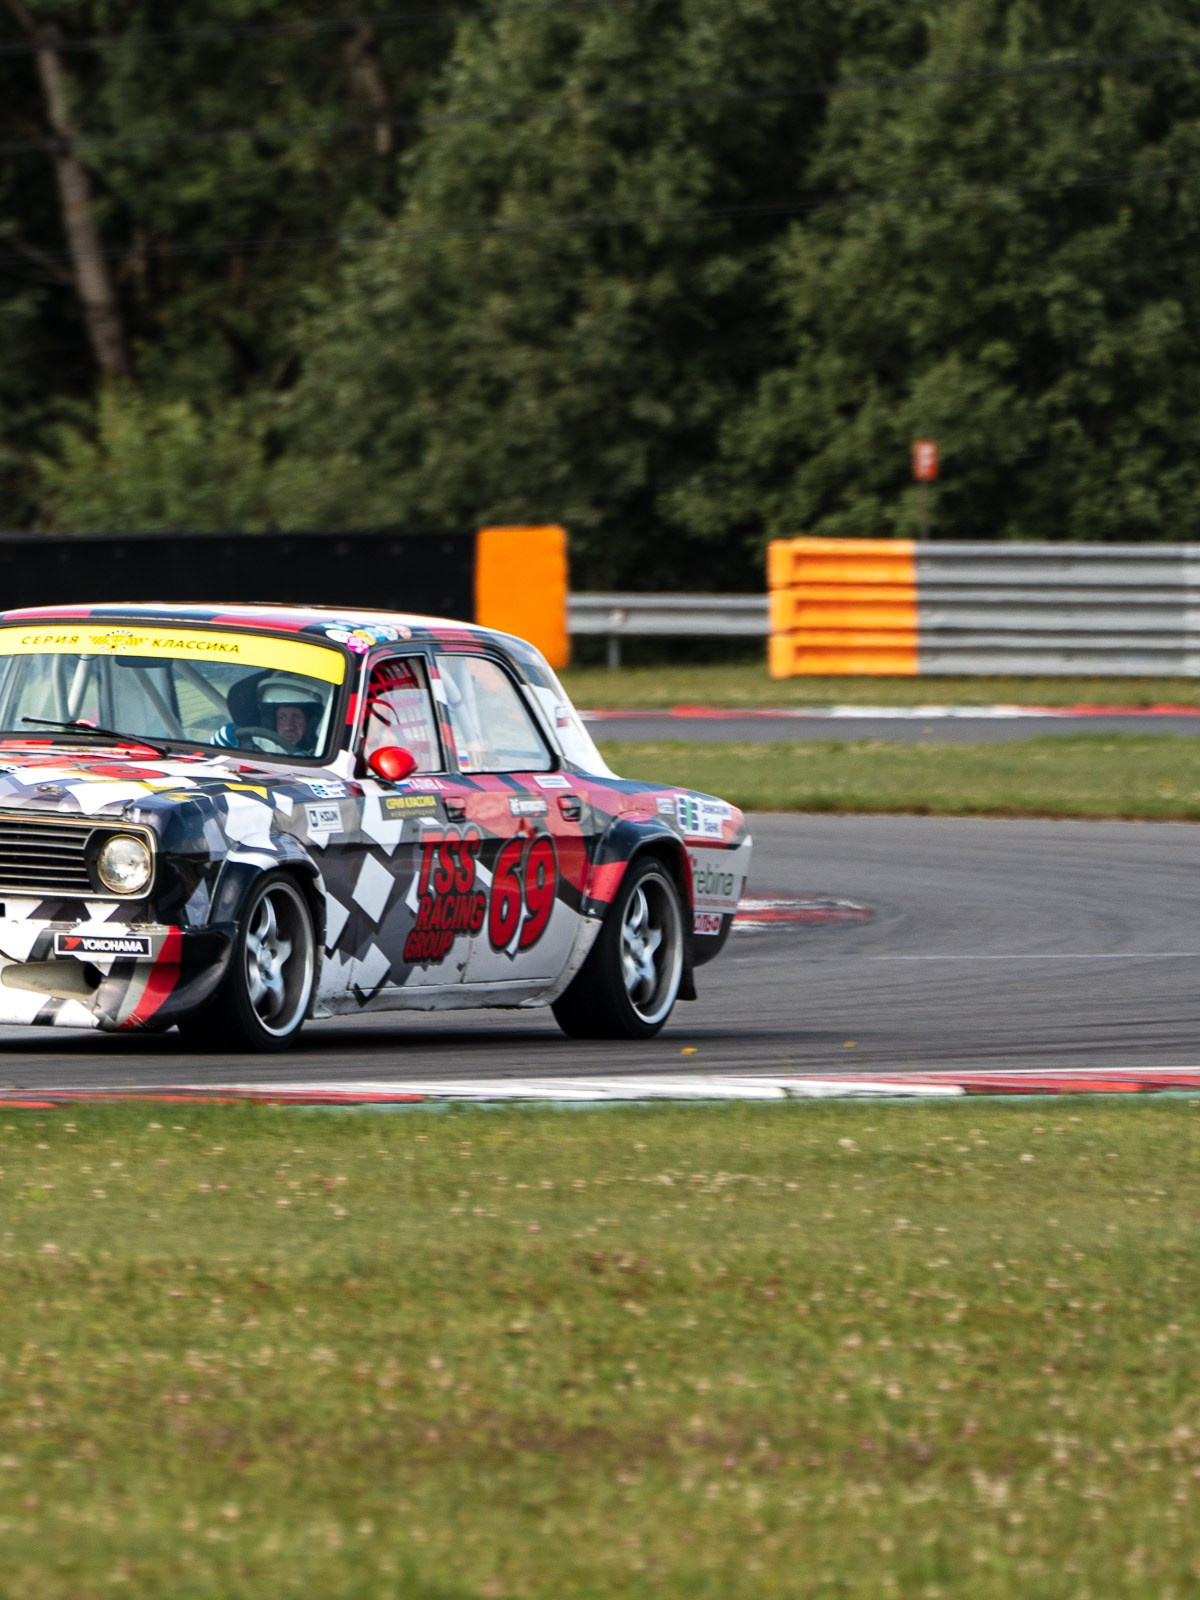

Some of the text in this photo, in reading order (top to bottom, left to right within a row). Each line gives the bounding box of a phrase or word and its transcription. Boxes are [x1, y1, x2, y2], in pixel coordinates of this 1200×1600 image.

[21, 635, 241, 654] СЕРИЯ КЛАССИКА
[417, 830, 481, 896] TSS
[488, 836, 558, 949] 69
[415, 894, 487, 932] RACING
[81, 938, 145, 953] YOKOHAMA
[403, 930, 455, 960] GROUP
